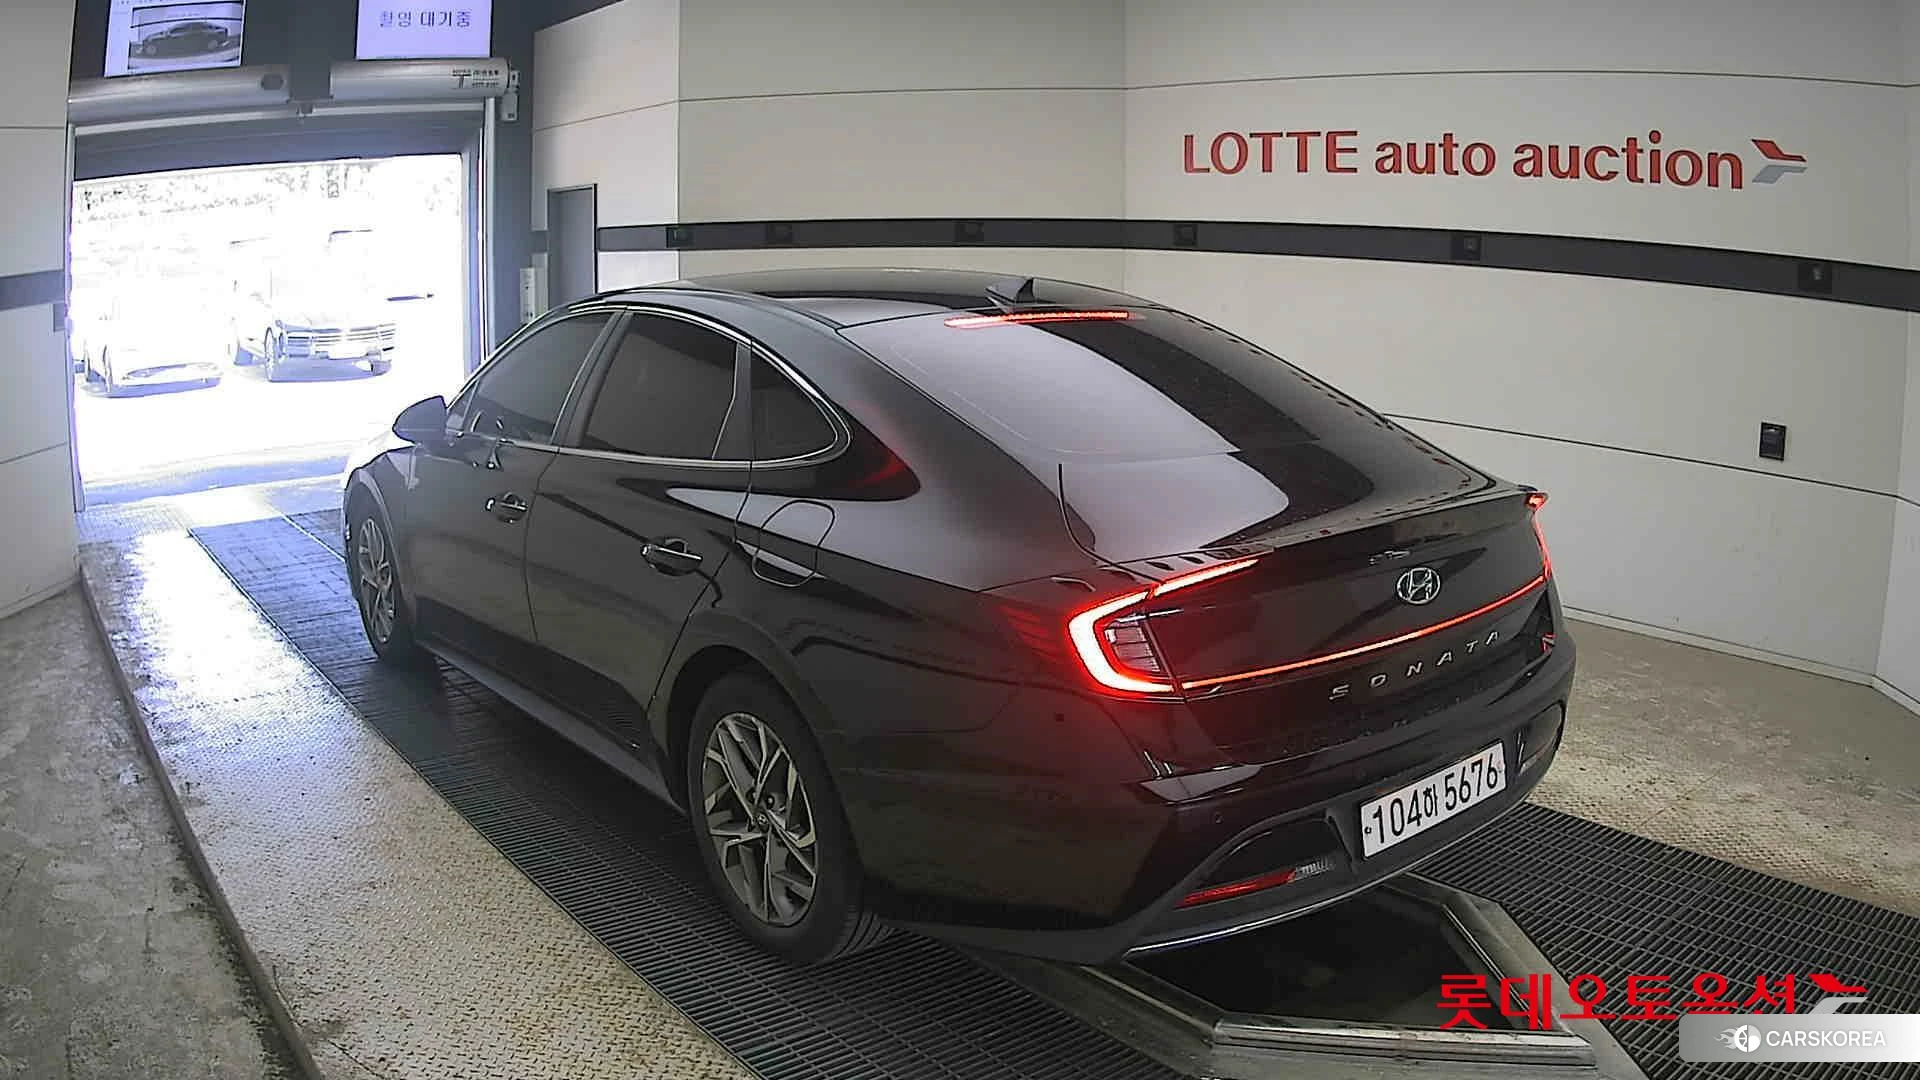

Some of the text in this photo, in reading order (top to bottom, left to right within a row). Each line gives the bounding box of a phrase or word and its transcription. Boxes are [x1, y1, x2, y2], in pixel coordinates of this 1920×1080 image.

[420, 10, 471, 28] 대기중
[1183, 129, 1744, 190] LOTTE auto auction
[1328, 631, 1500, 701] SONATA
[1372, 752, 1499, 844] 104하 5676
